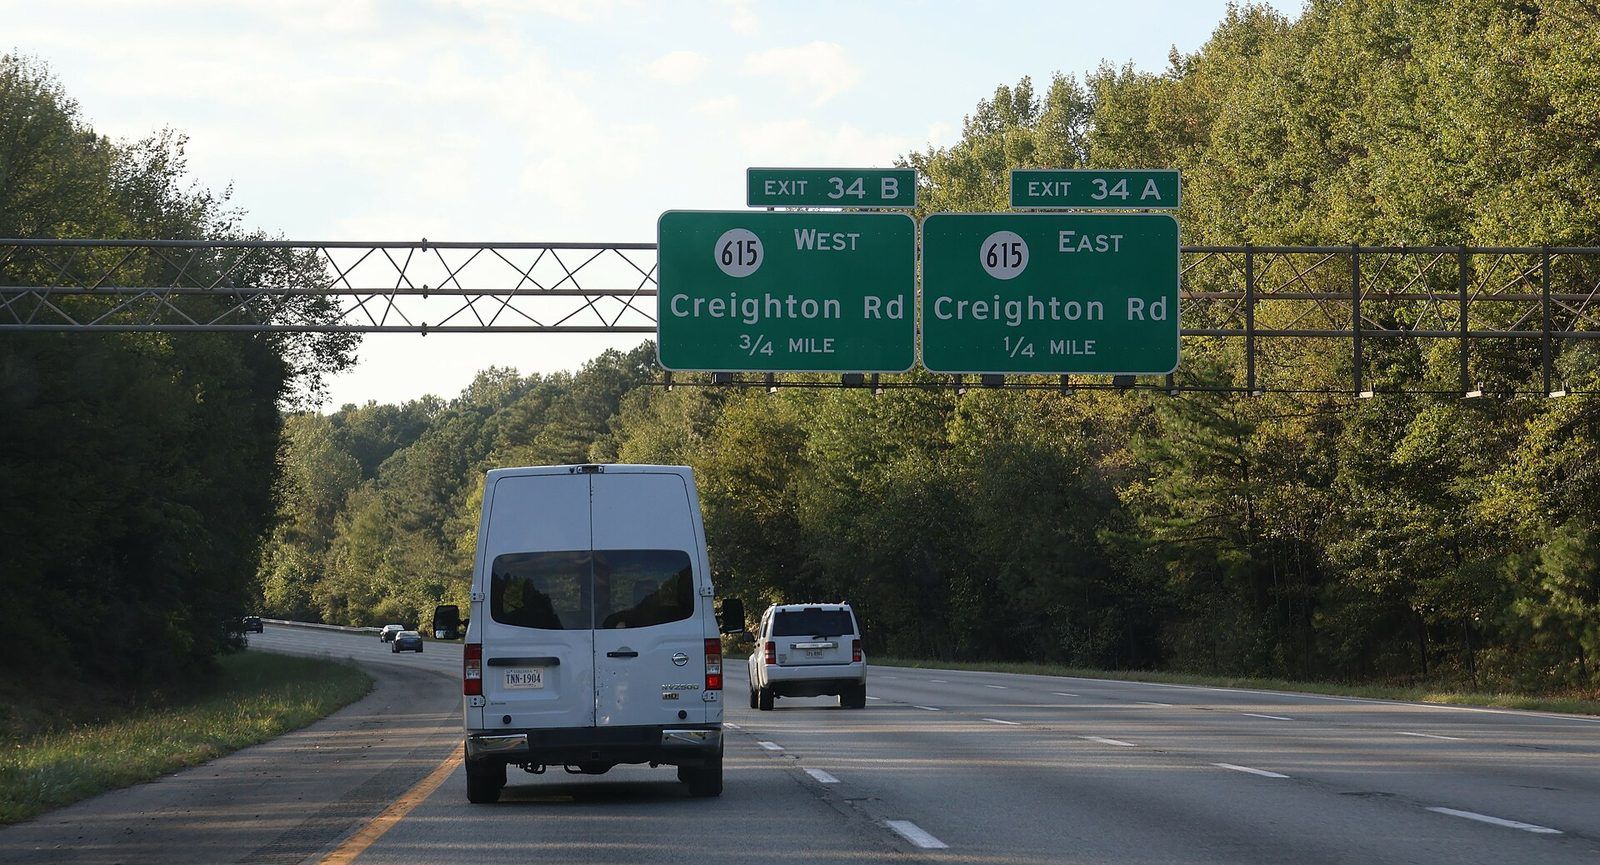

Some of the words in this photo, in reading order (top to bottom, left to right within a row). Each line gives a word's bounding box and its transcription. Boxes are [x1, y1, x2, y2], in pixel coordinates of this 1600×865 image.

[764, 180, 808, 196] EXIT
[827, 177, 866, 199] 34
[881, 177, 899, 199] B
[1028, 181, 1072, 197] EXIT
[1090, 178, 1130, 200] 34
[1140, 178, 1162, 200] A
[794, 228, 860, 251] WEST
[1059, 230, 1124, 253] EAST
[721, 240, 758, 267] 615
[986, 242, 1023, 269] 615
[670, 292, 841, 325] Creighton
[864, 294, 904, 319] Rd
[934, 294, 1104, 327] Creighton
[1127, 296, 1167, 321] Rd
[739, 334, 774, 356] 3/4
[789, 338, 835, 353] MILE
[1004, 336, 1035, 358] 1/4
[1050, 340, 1096, 355] MILE
